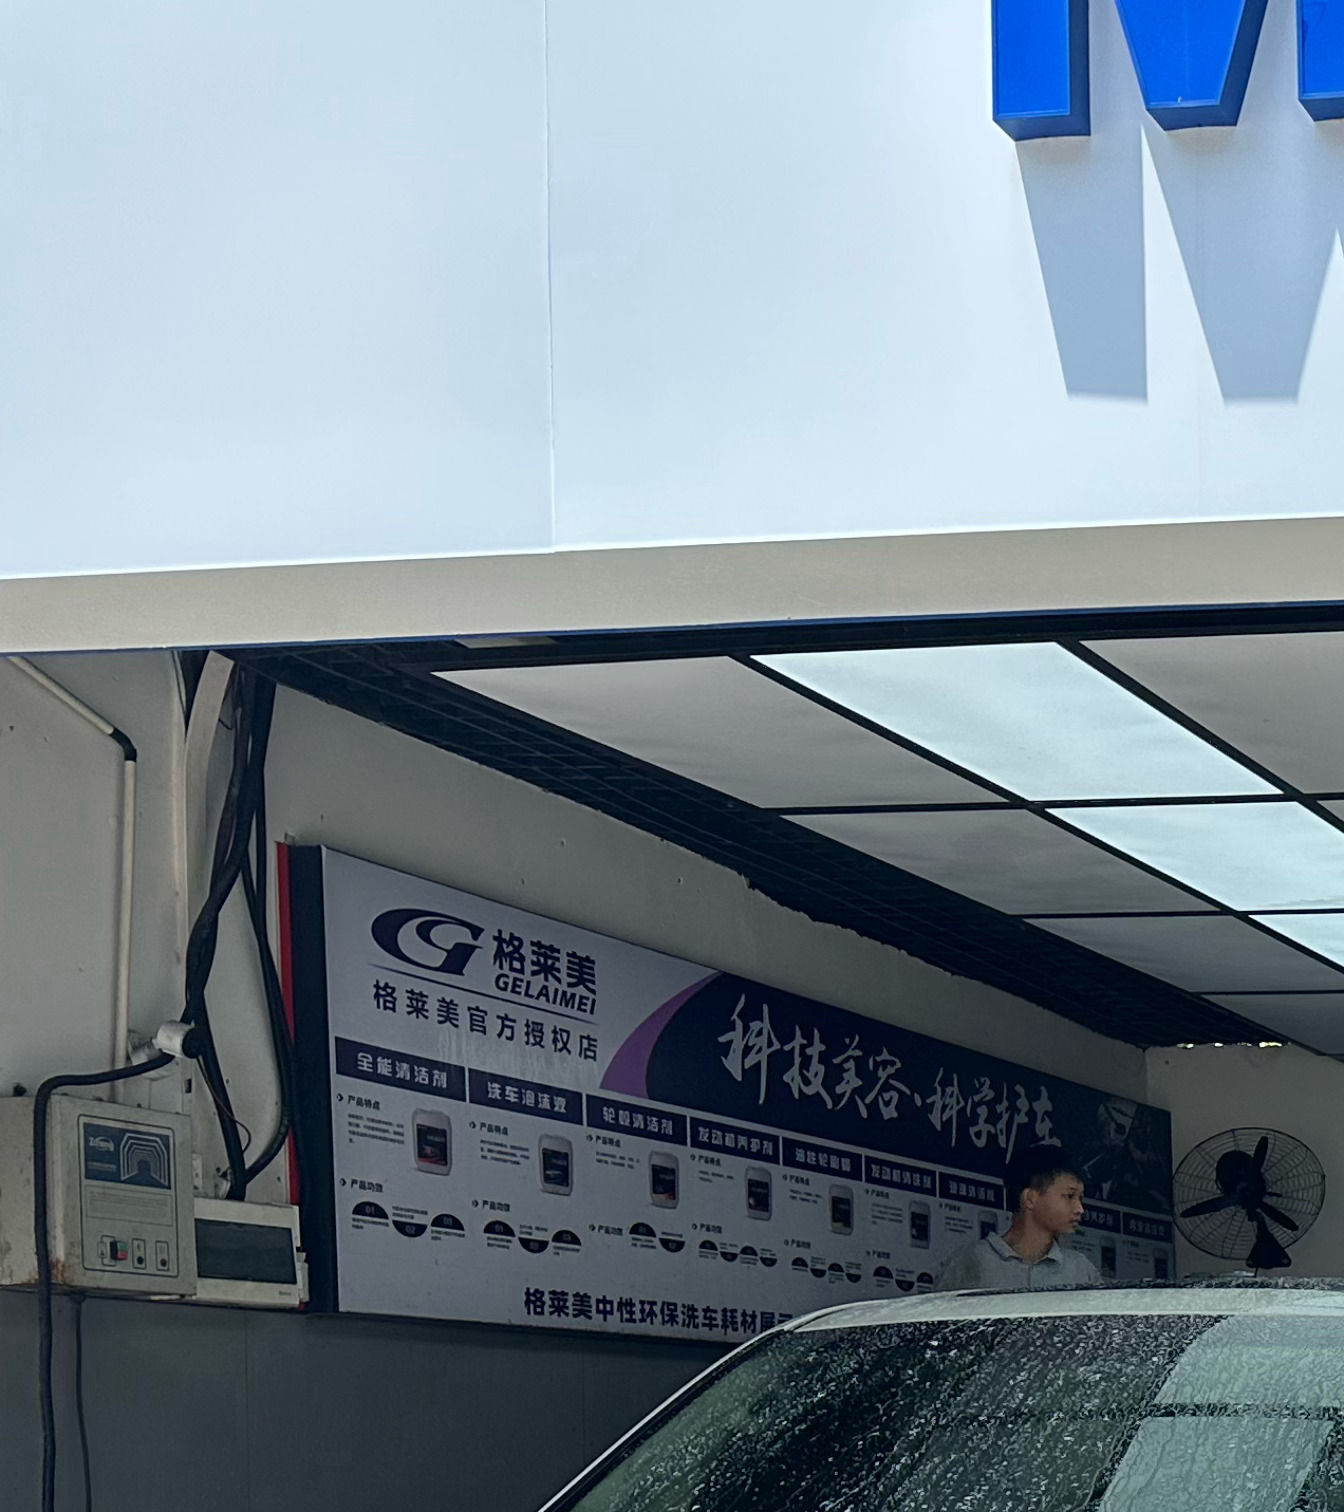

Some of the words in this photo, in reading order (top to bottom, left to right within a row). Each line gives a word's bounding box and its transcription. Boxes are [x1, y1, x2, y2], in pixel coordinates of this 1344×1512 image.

[492, 930, 597, 995] 格莱美
[495, 972, 596, 1016] GELAIMEI
[373, 979, 598, 1061] 格莱美官方授权店
[357, 1052, 447, 1089] 全能清洁剂
[602, 1106, 673, 1136] 轮毂清洁剂
